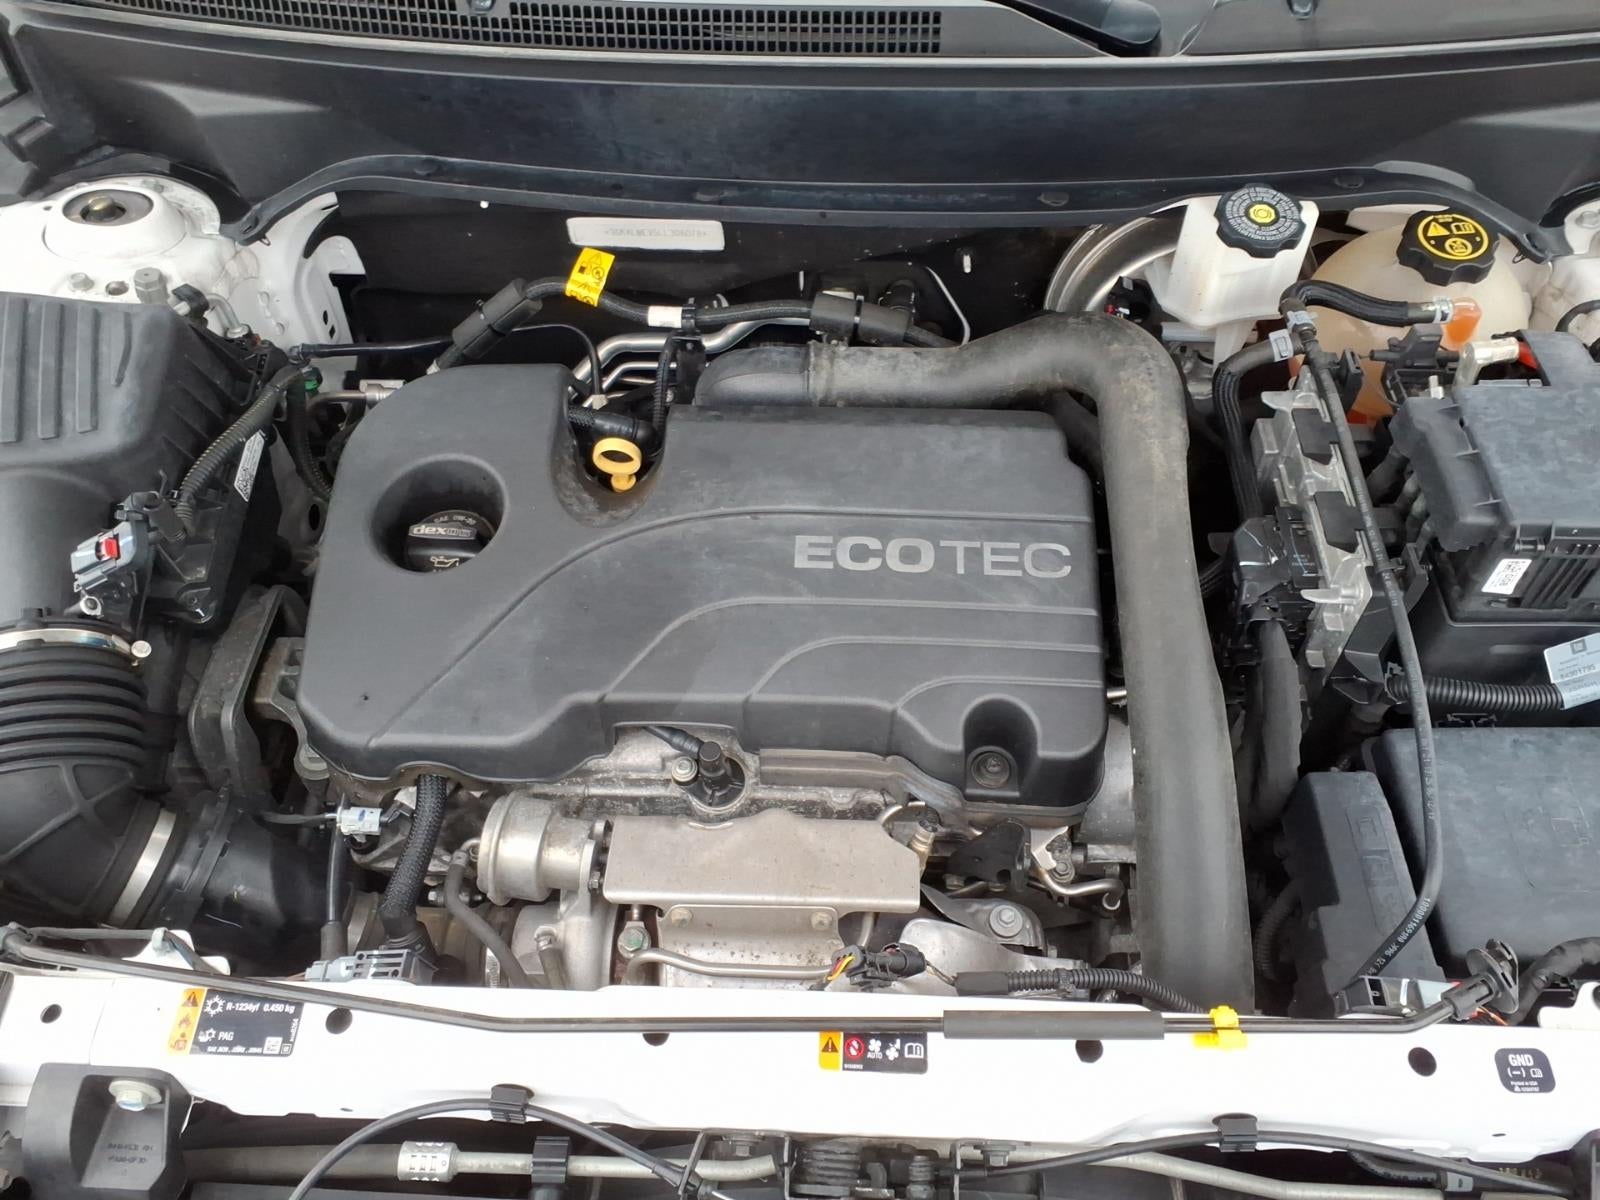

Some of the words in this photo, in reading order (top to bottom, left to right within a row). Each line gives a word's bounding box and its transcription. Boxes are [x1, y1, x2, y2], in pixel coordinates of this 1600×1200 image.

[794, 534, 1072, 579] ECOTEC
[226, 1001, 260, 1014] R-1234yf
[263, 1003, 284, 1013] 0.450
[284, 1003, 296, 1015] kg
[218, 1031, 235, 1041] PAG
[867, 1052, 883, 1060] AUTO
[1508, 1054, 1534, 1067] GND
